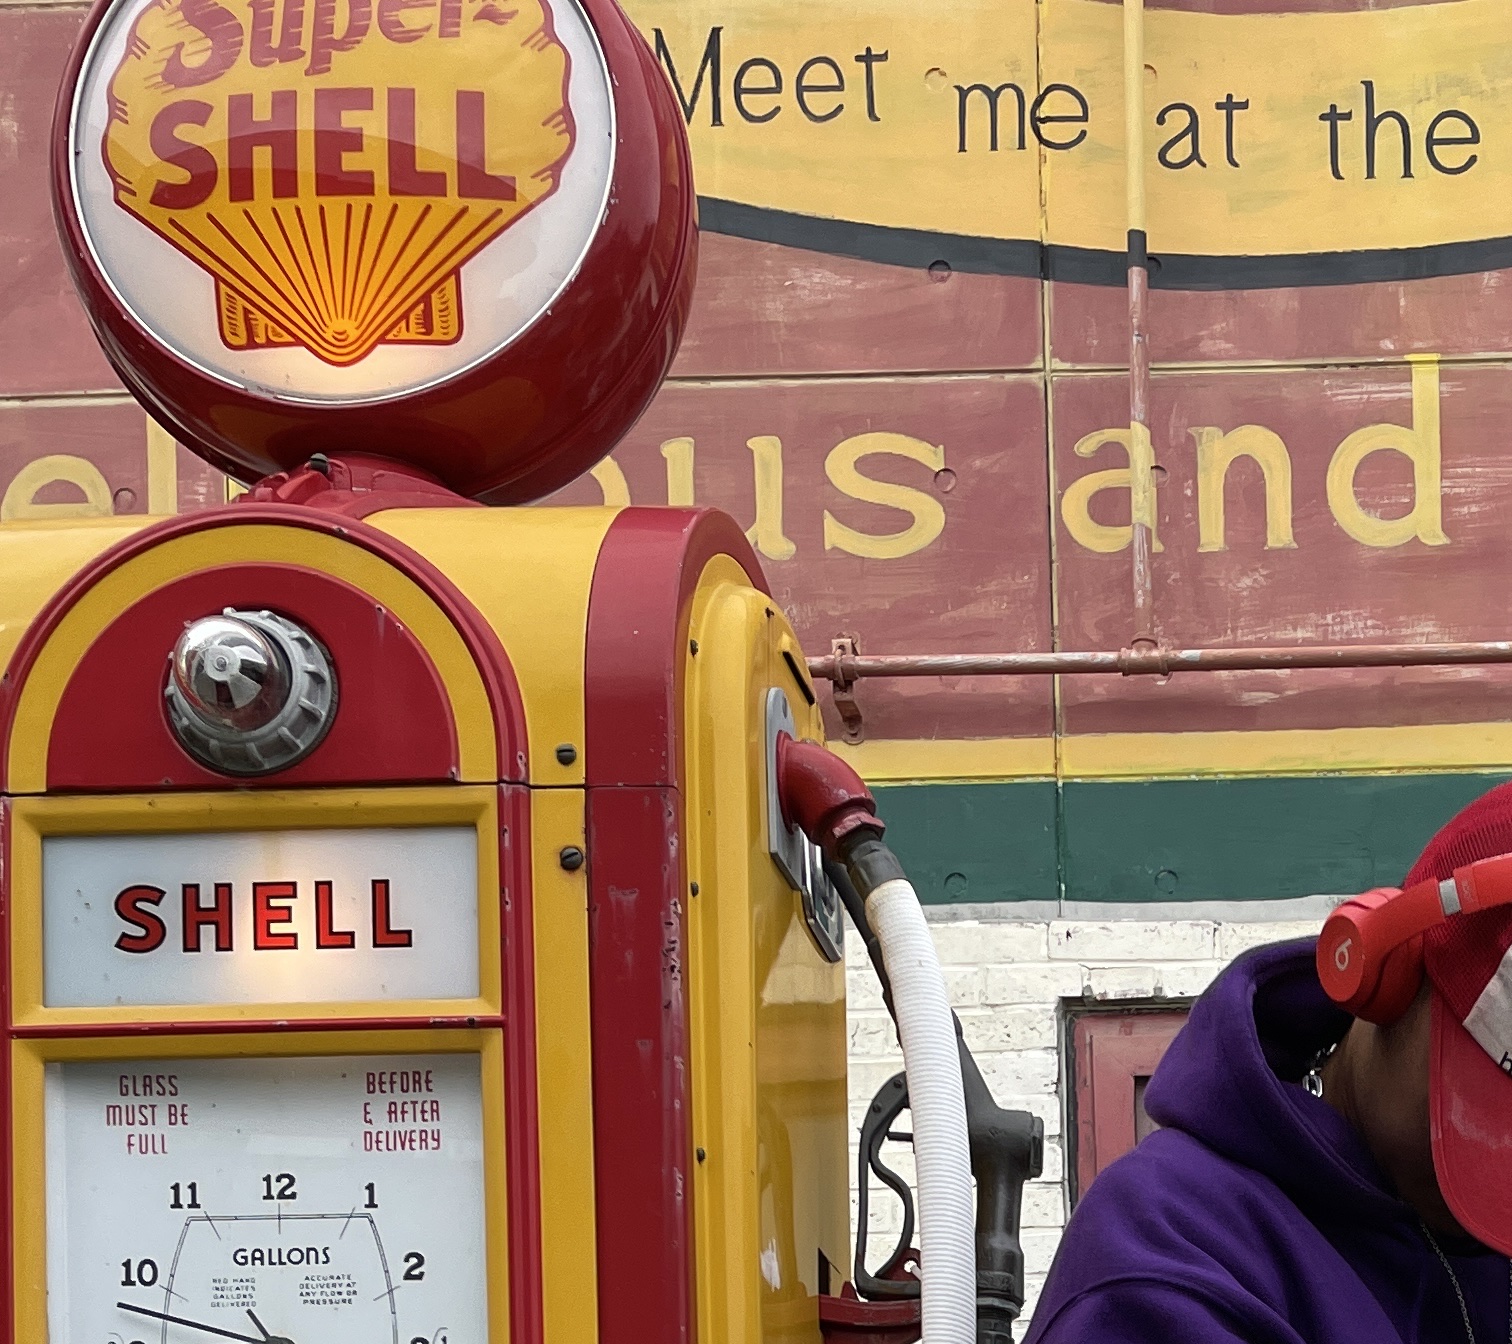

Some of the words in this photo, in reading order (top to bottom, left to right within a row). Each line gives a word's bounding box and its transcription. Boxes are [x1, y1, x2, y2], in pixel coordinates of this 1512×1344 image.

[654, 26, 889, 128] Meet
[954, 80, 1089, 153] me
[1156, 93, 1249, 170] at
[1319, 79, 1481, 181] the
[149, 88, 518, 208] SHELL
[1061, 353, 1453, 554] and
[114, 879, 414, 954] SHELL
[118, 1074, 180, 1098] GLASS
[365, 1070, 434, 1095] BEFORE
[105, 1104, 157, 1127] MUST
[168, 1104, 189, 1126] BE
[386, 1099, 441, 1123] AFTER
[127, 1133, 168, 1156] FULL
[363, 1128, 442, 1153] DELIVERY
[169, 1182, 201, 1210] 11
[261, 1172, 297, 1201] 12
[364, 1182, 378, 1210] 1
[232, 1246, 331, 1266] GALLONS
[403, 1252, 426, 1281] 2
[120, 1258, 158, 1287] 10
[304, 1273, 352, 1281] ACCURATE
[299, 1282, 343, 1290] DELIVERY
[302, 1298, 353, 1306] PRESSURE
